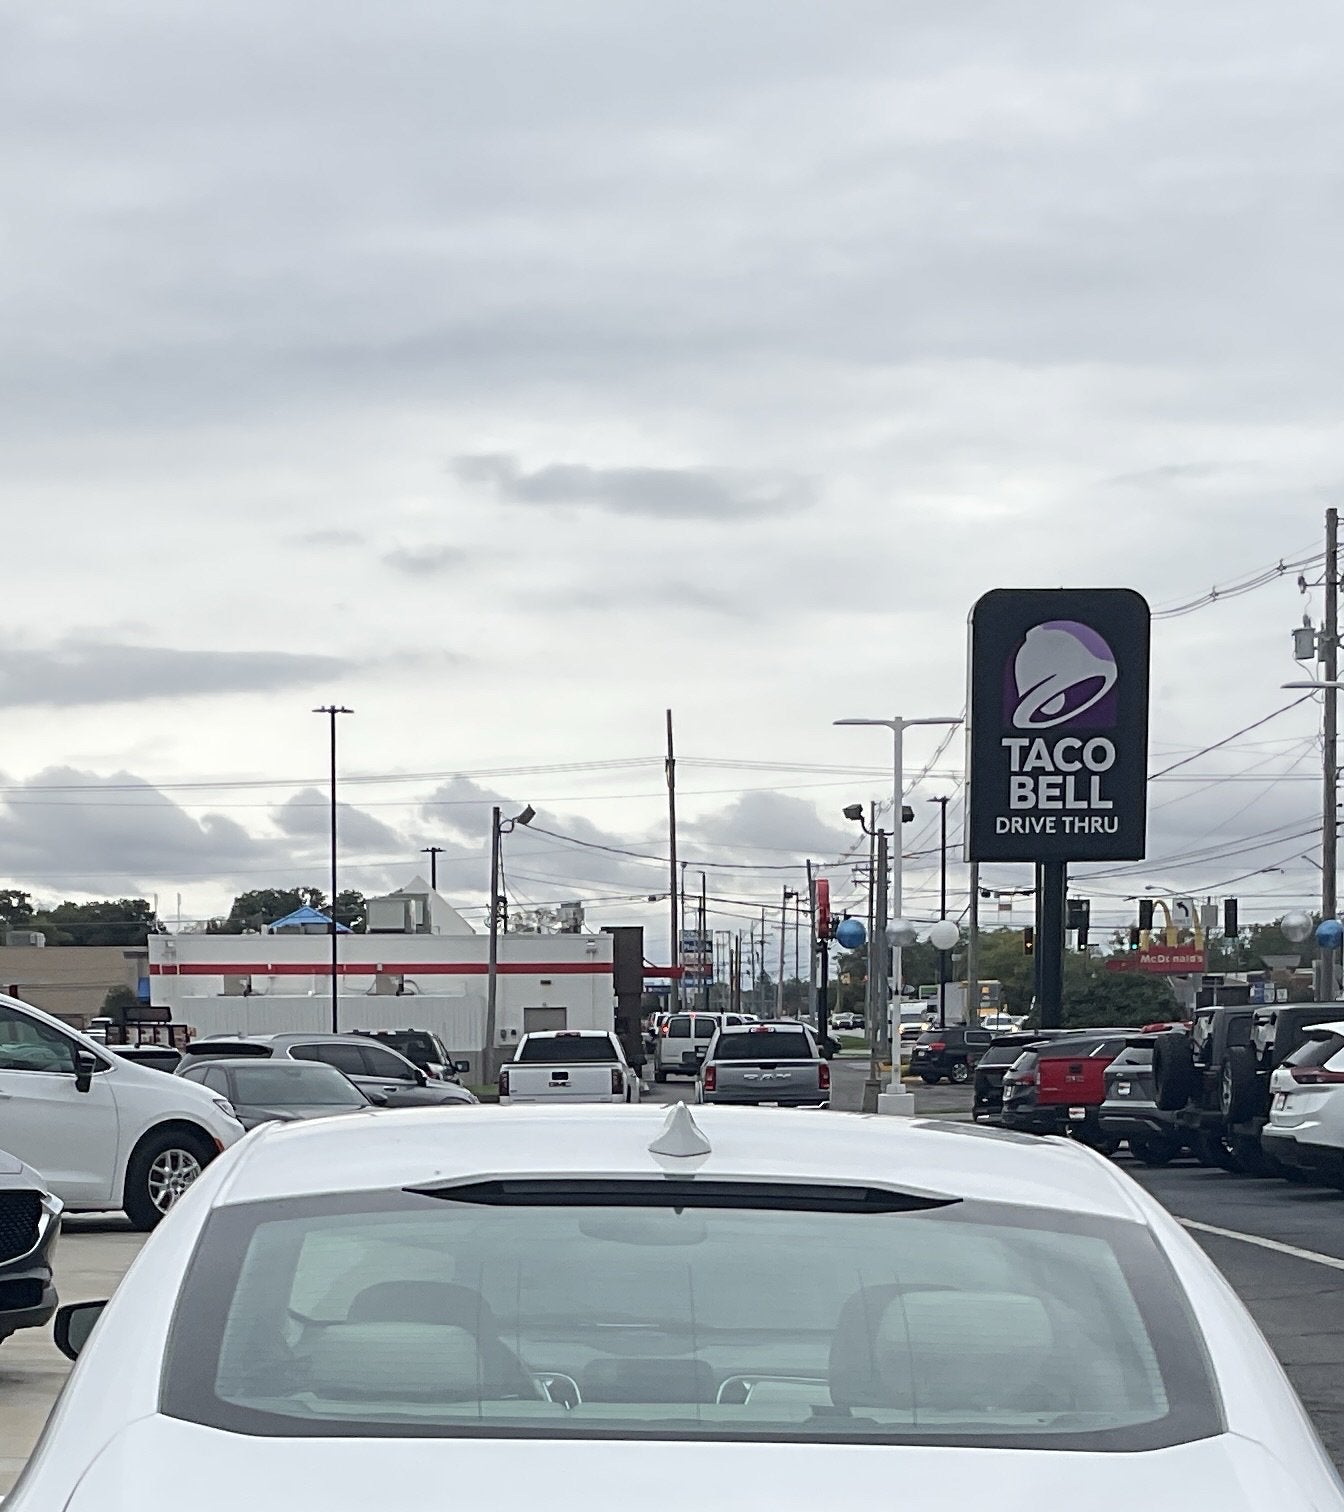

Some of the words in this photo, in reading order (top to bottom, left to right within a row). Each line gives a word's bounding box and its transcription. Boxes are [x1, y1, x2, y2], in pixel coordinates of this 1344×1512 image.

[1001, 737, 1116, 772] TACO
[1009, 775, 1113, 809] BELL
[996, 816, 1057, 834] DRIVE
[1061, 816, 1119, 834] THRU
